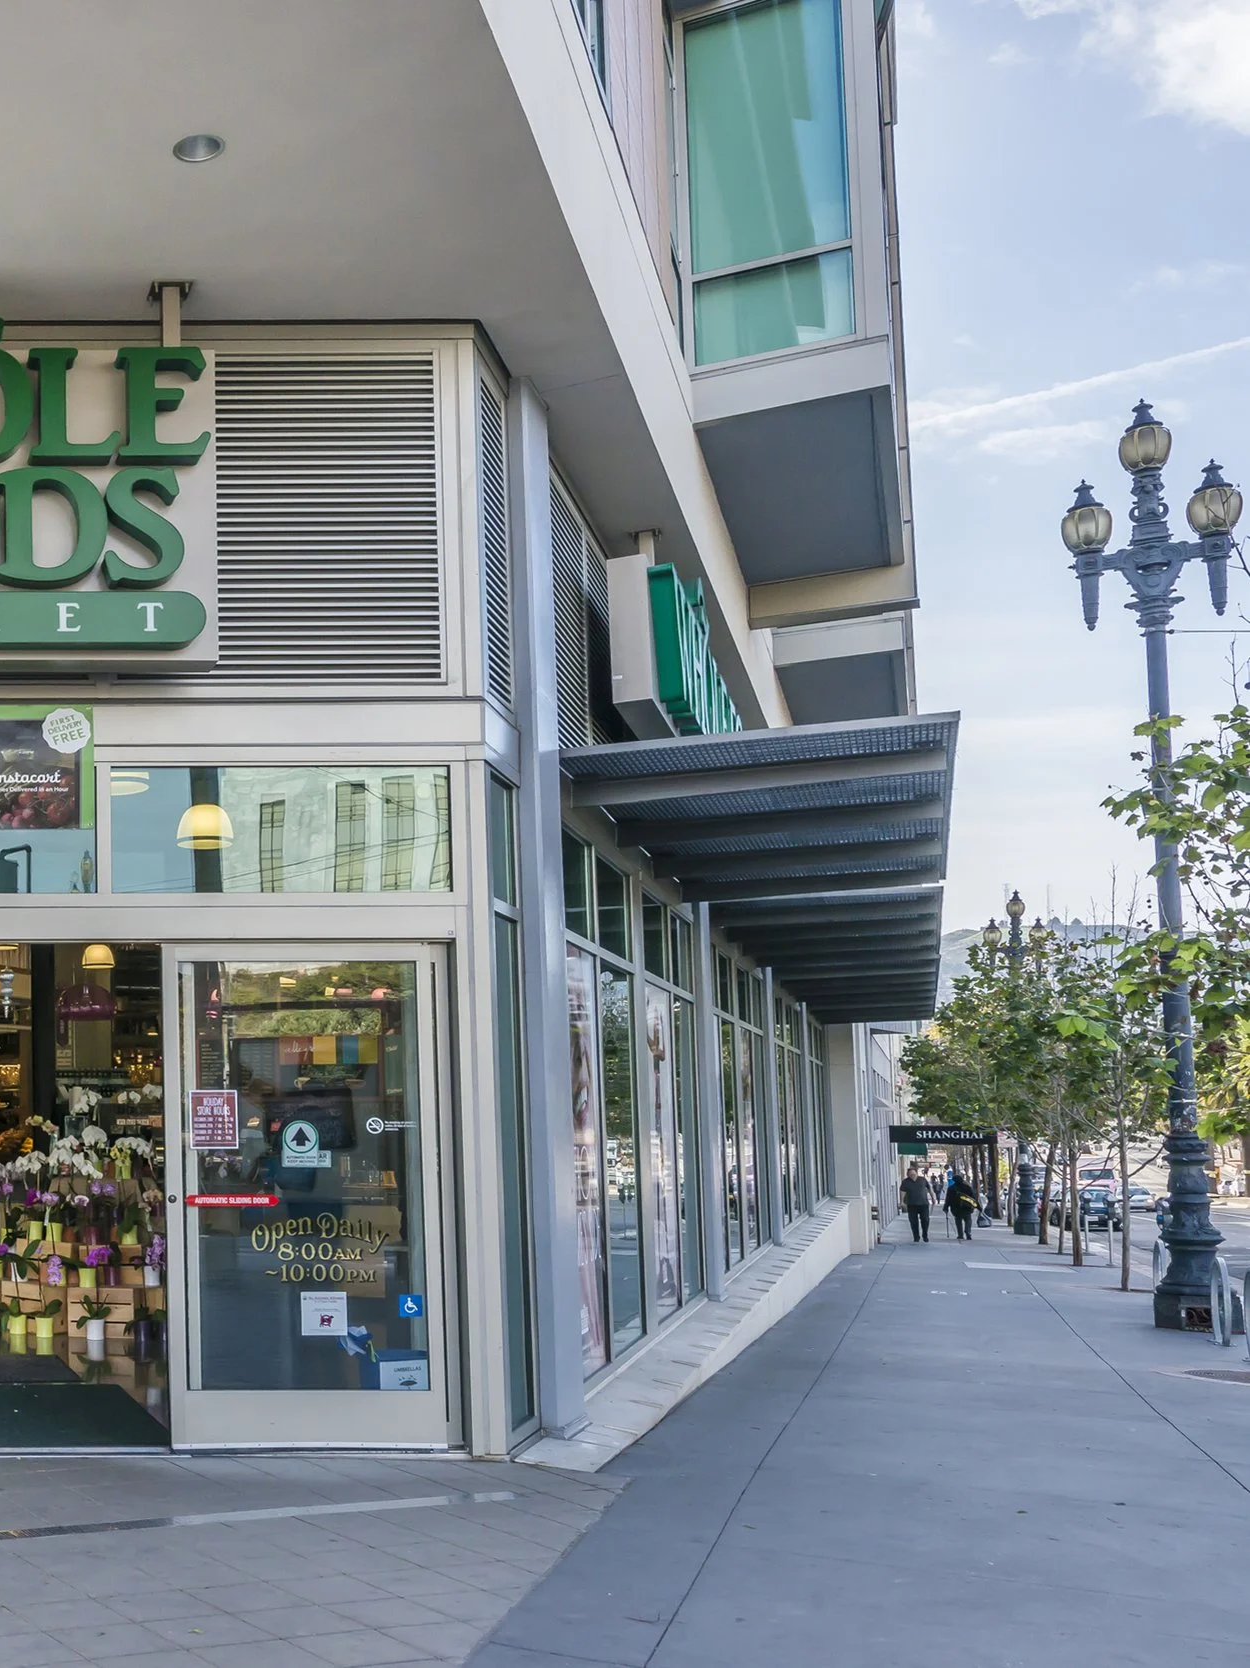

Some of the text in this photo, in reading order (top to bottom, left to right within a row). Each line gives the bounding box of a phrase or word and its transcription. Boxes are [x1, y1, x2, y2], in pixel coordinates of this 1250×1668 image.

[48, 720, 82, 734] DELIVERY
[50, 715, 75, 727] FIRST
[53, 728, 86, 745] FREE
[251, 1212, 389, 1253] Open Daily
[278, 1242, 362, 1261] 8:00AM
